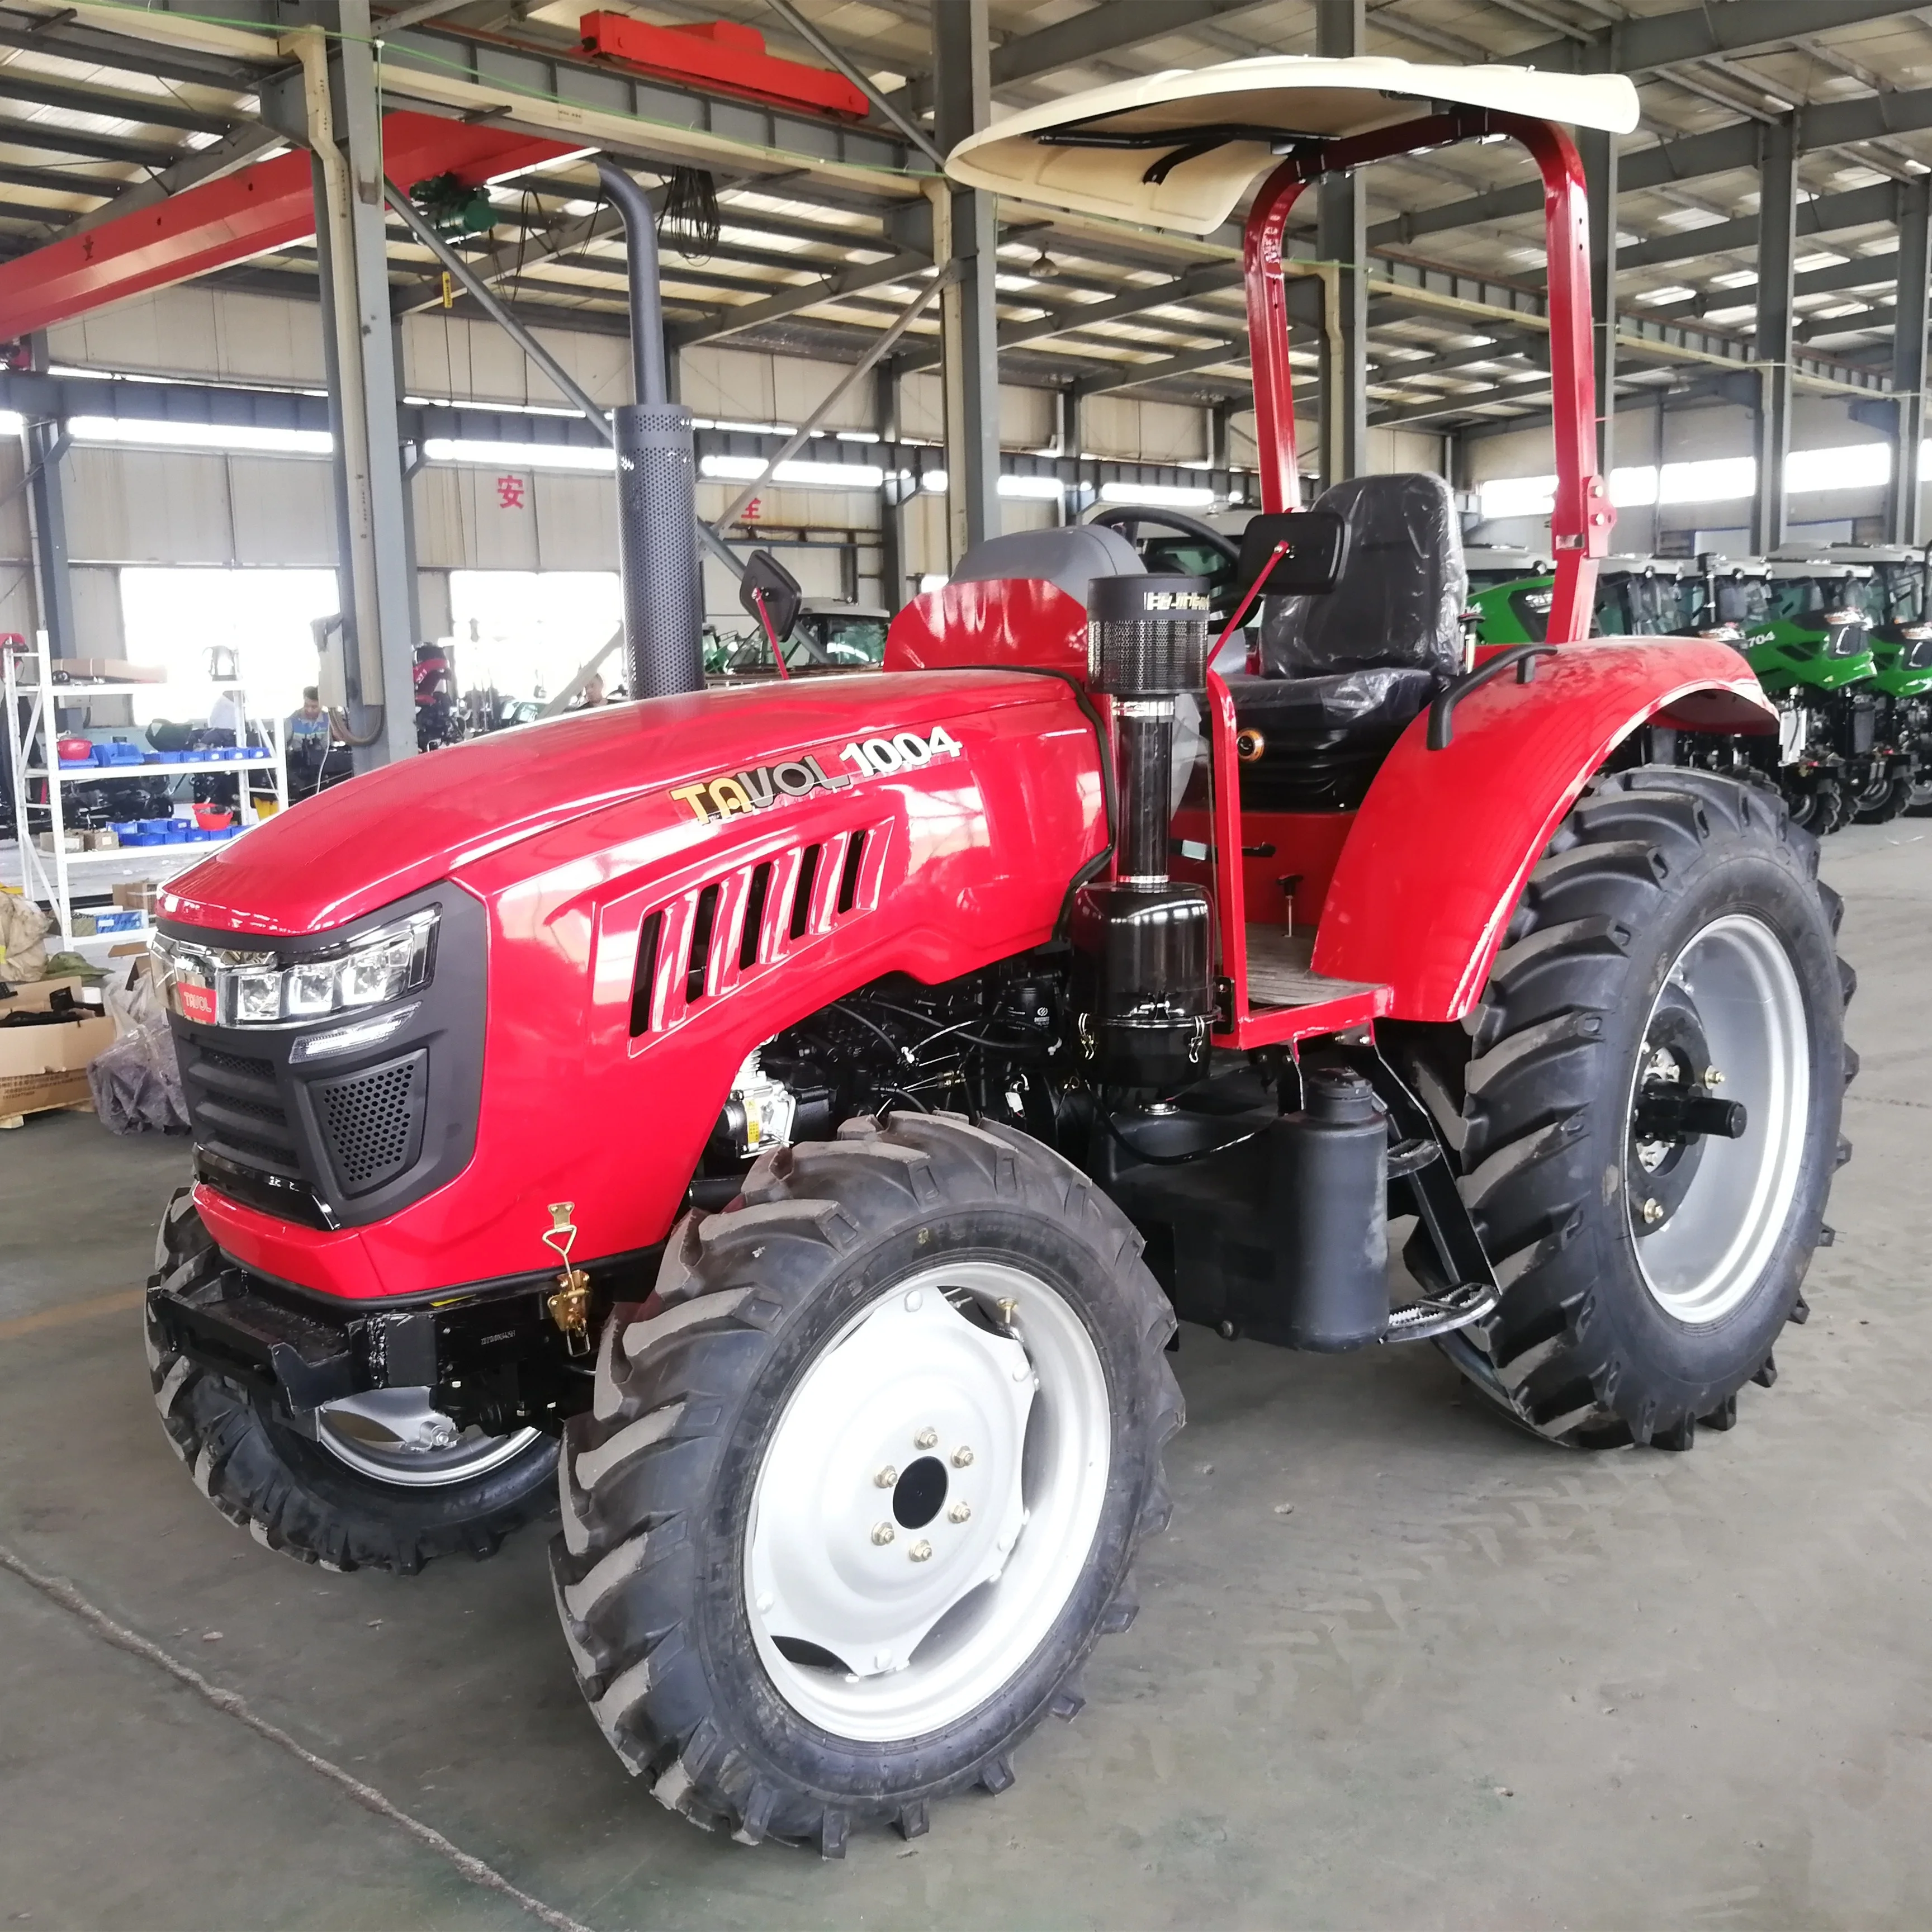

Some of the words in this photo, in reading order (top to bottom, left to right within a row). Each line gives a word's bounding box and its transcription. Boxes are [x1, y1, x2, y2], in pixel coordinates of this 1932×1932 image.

[497, 475, 524, 509] 安
[669, 755, 851, 825] TAVOL
[839, 726, 964, 778] 1004
[183, 991, 212, 1013] TAVOL
